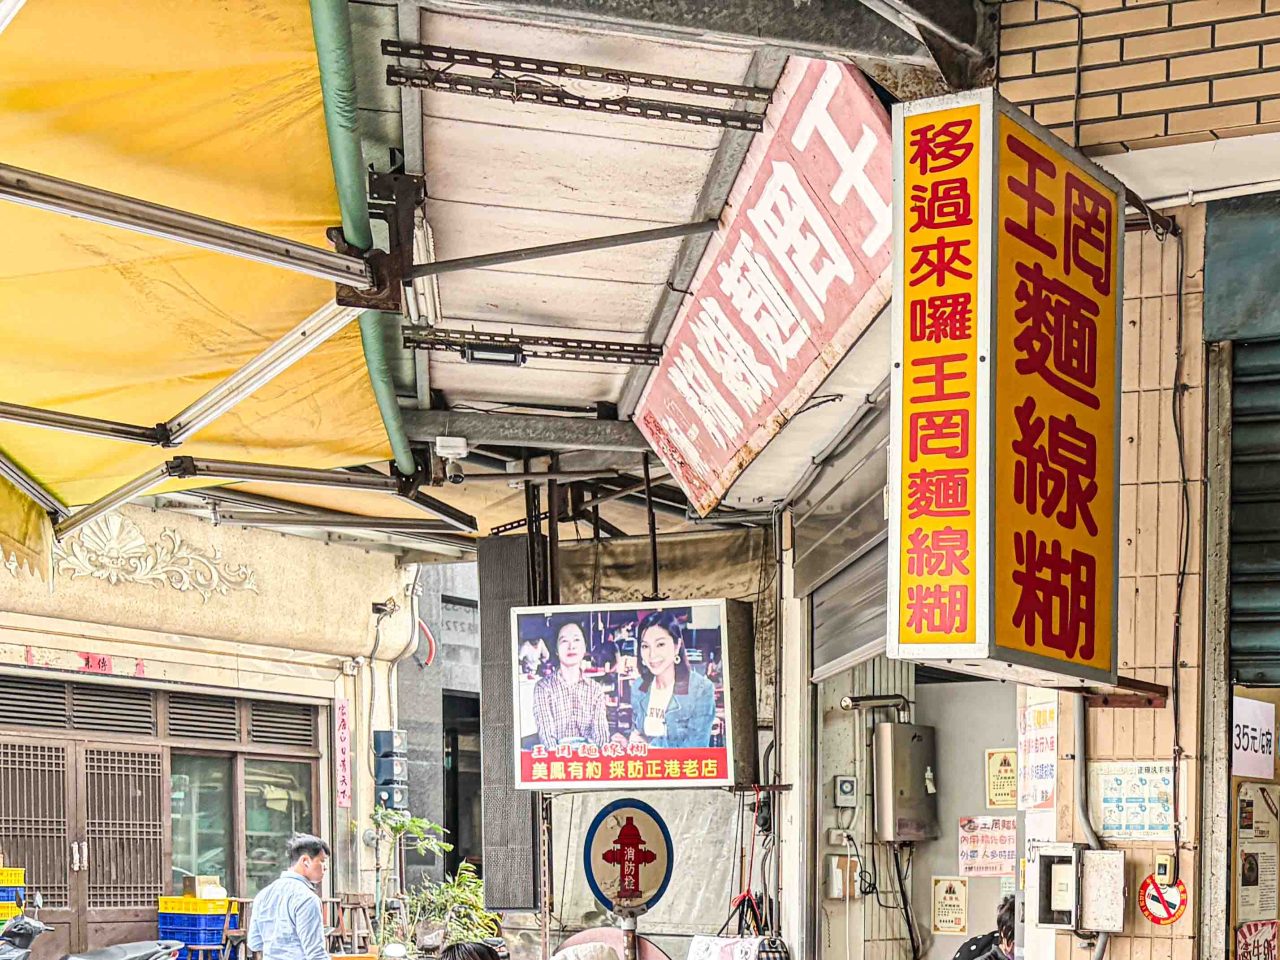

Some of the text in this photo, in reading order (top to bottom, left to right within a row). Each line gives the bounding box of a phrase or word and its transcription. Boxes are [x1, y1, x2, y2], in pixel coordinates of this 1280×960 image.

[907, 119, 973, 634] 移過來囉王罔麵線糊
[1234, 723, 1272, 756] 35元/碗
[532, 758, 718, 779] 美鳳有約 採訪正港老店
[624, 846, 635, 889] 消防栓
